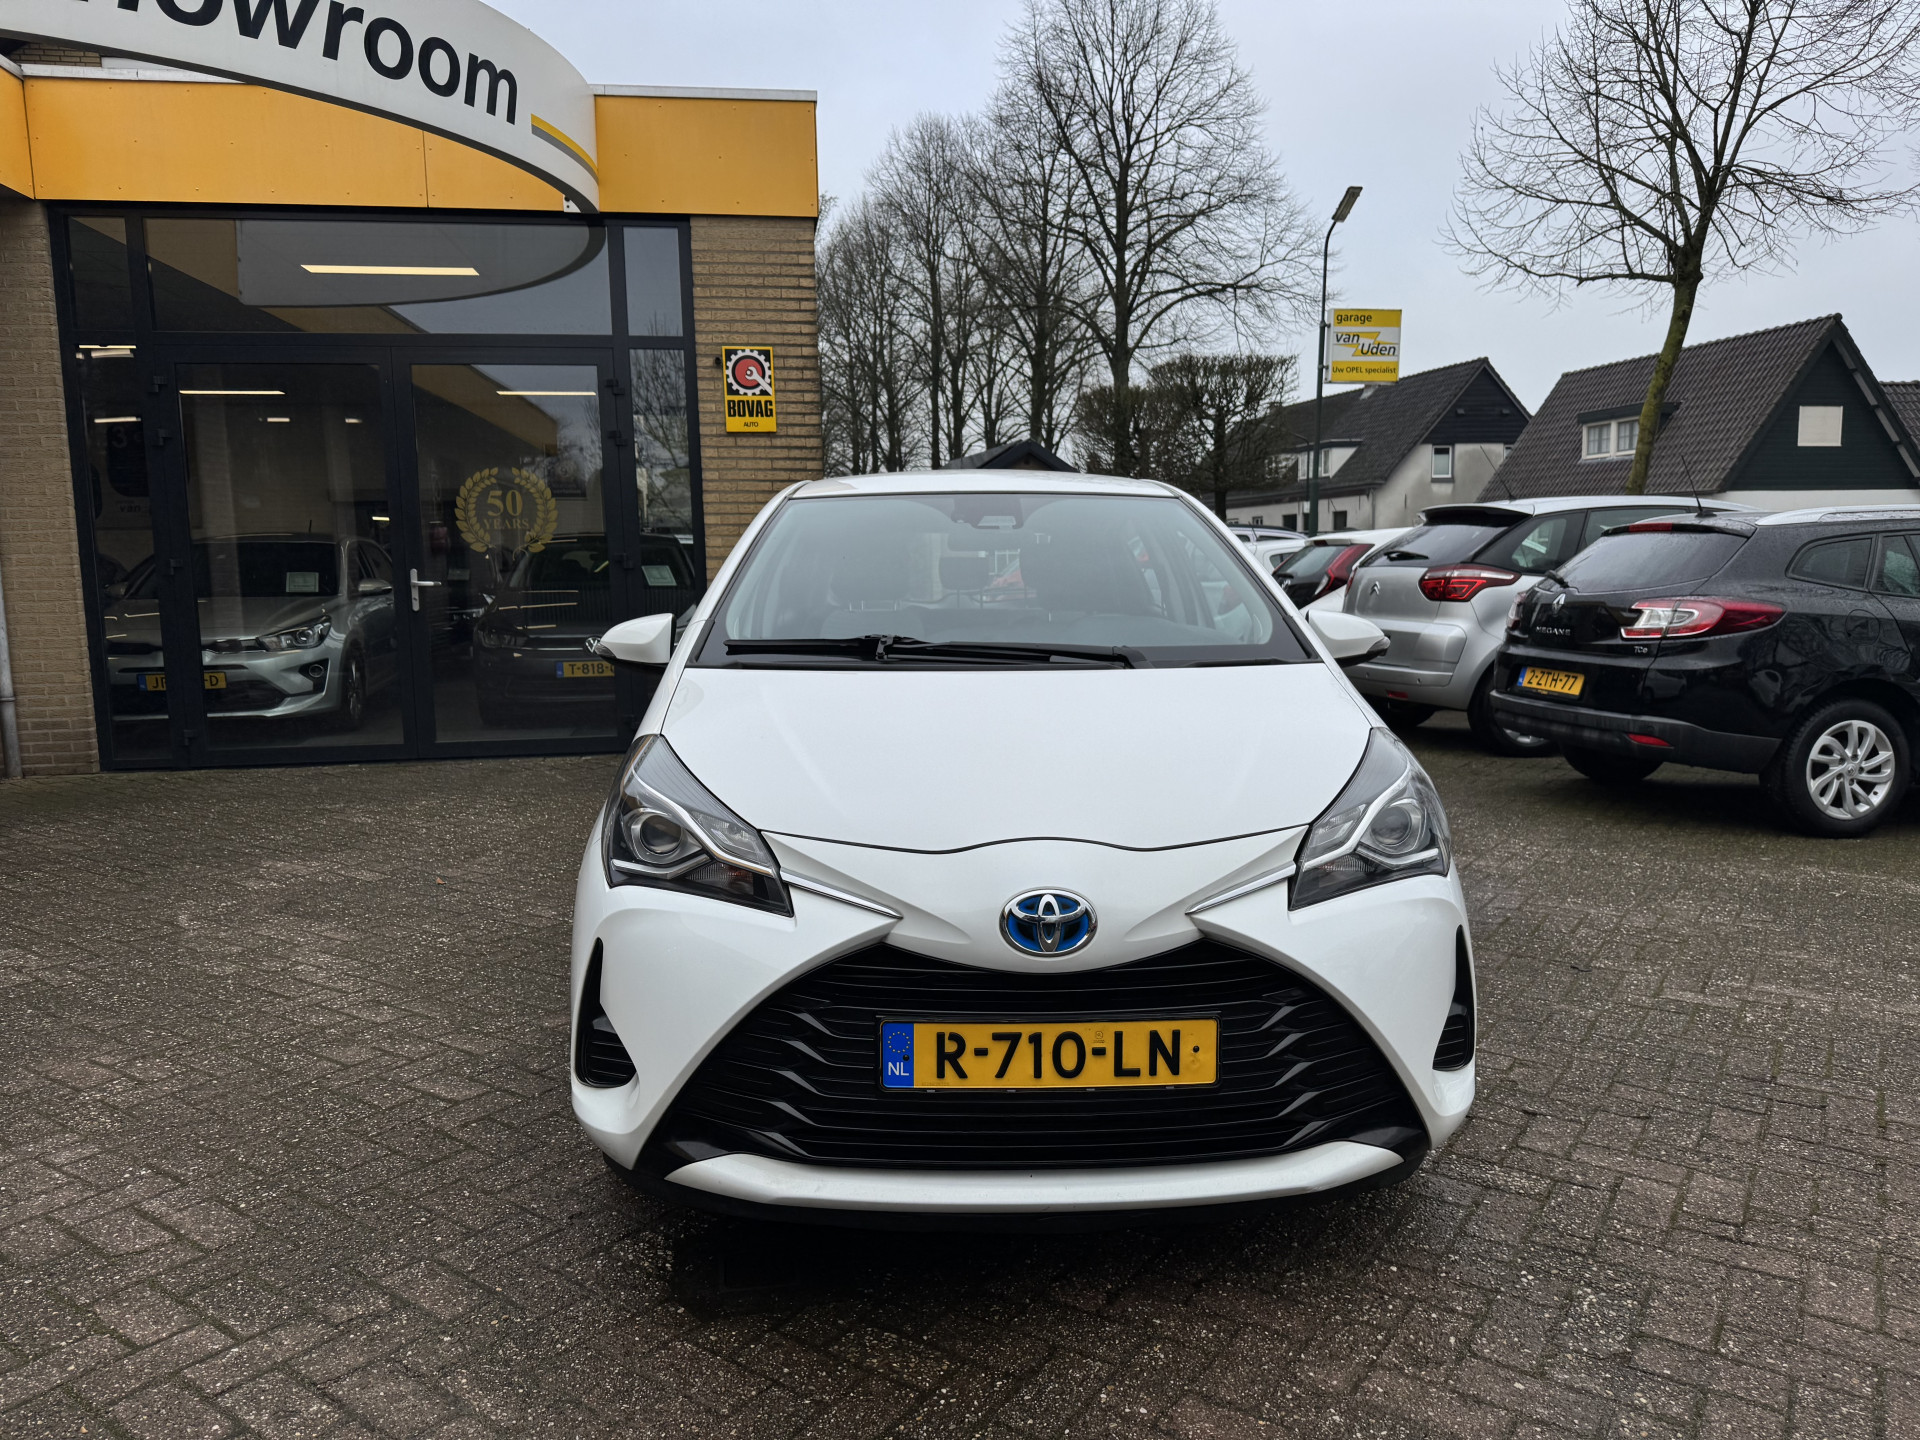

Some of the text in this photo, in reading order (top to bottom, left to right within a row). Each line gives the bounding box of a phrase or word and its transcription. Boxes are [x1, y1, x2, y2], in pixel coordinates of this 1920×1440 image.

[1336, 314, 1373, 325] garage
[1335, 333, 1397, 356] van Uden
[1332, 366, 1397, 375] Uw OPEL specialist
[727, 400, 774, 418] BOVAG
[487, 490, 523, 517] 50
[481, 519, 530, 530] YEARS
[1527, 666, 1579, 692] 2-ZTH-77
[936, 1029, 1181, 1079] R-710-LN
[887, 1061, 910, 1076] NL
